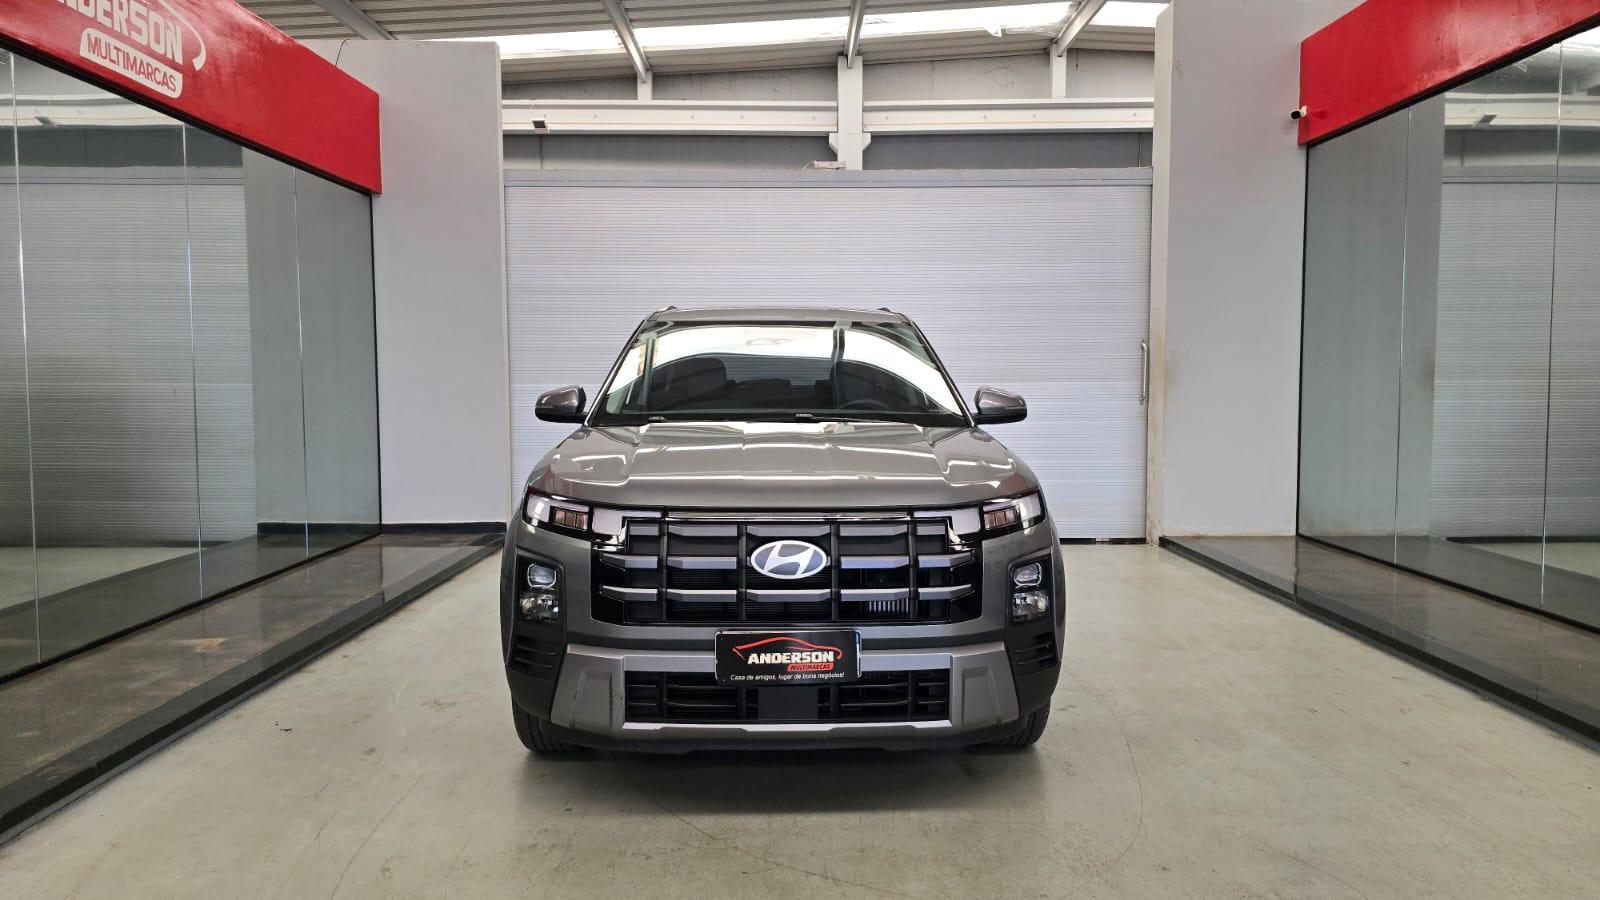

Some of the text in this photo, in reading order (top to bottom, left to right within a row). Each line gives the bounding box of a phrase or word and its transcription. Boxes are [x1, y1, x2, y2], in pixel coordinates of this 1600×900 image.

[87, 32, 177, 92] MULTIMARCAS
[747, 651, 834, 665] ANDERSON
[790, 663, 830, 671] MULTIMARCAS
[755, 674, 776, 682] amigos,
[778, 673, 793, 681] lugar
[793, 672, 802, 680] de
